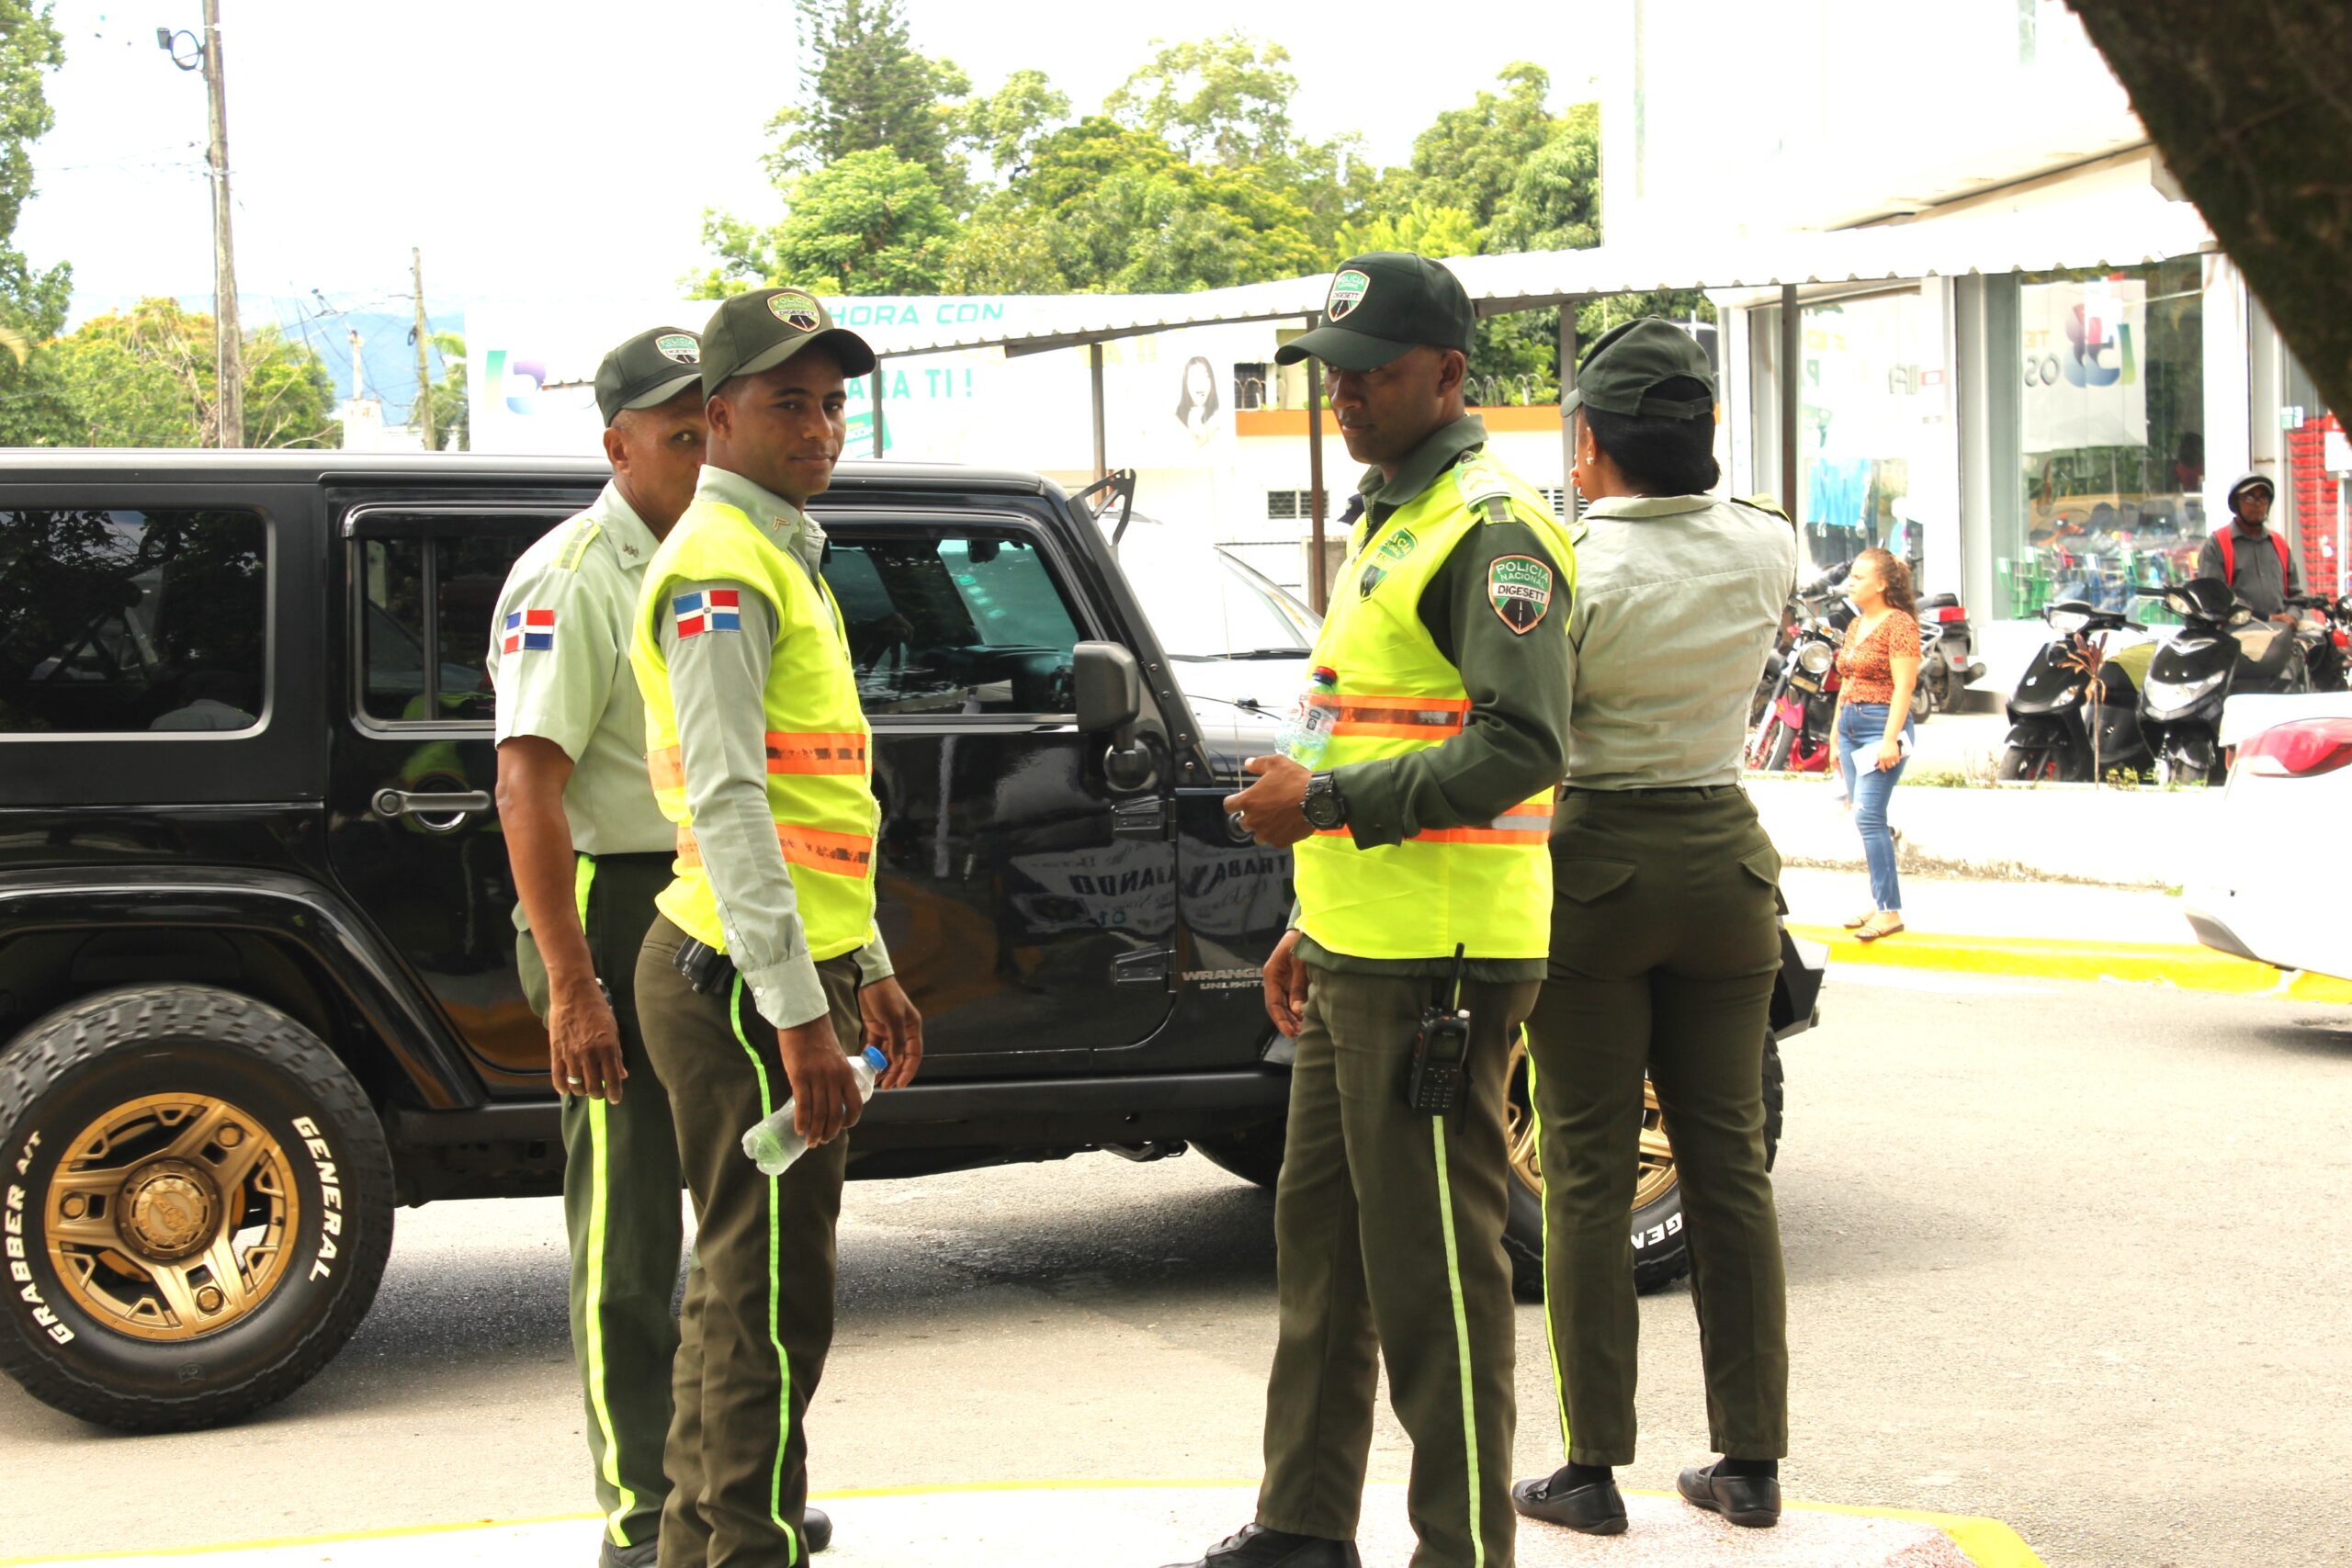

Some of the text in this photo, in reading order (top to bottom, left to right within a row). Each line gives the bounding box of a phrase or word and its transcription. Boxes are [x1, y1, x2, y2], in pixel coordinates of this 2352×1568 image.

[936, 302, 1004, 324] CON
[1496, 561, 1549, 583] POLICIA
[1499, 571, 1545, 589] NACIONAL
[1498, 585, 1545, 603] DIGESETT
[1182, 967, 1264, 981] WRANGL
[1199, 980, 1264, 990] UNLIMIT
[291, 1115, 342, 1282] GENERAL
[5, 1130, 75, 1345] GRABBER A/T
